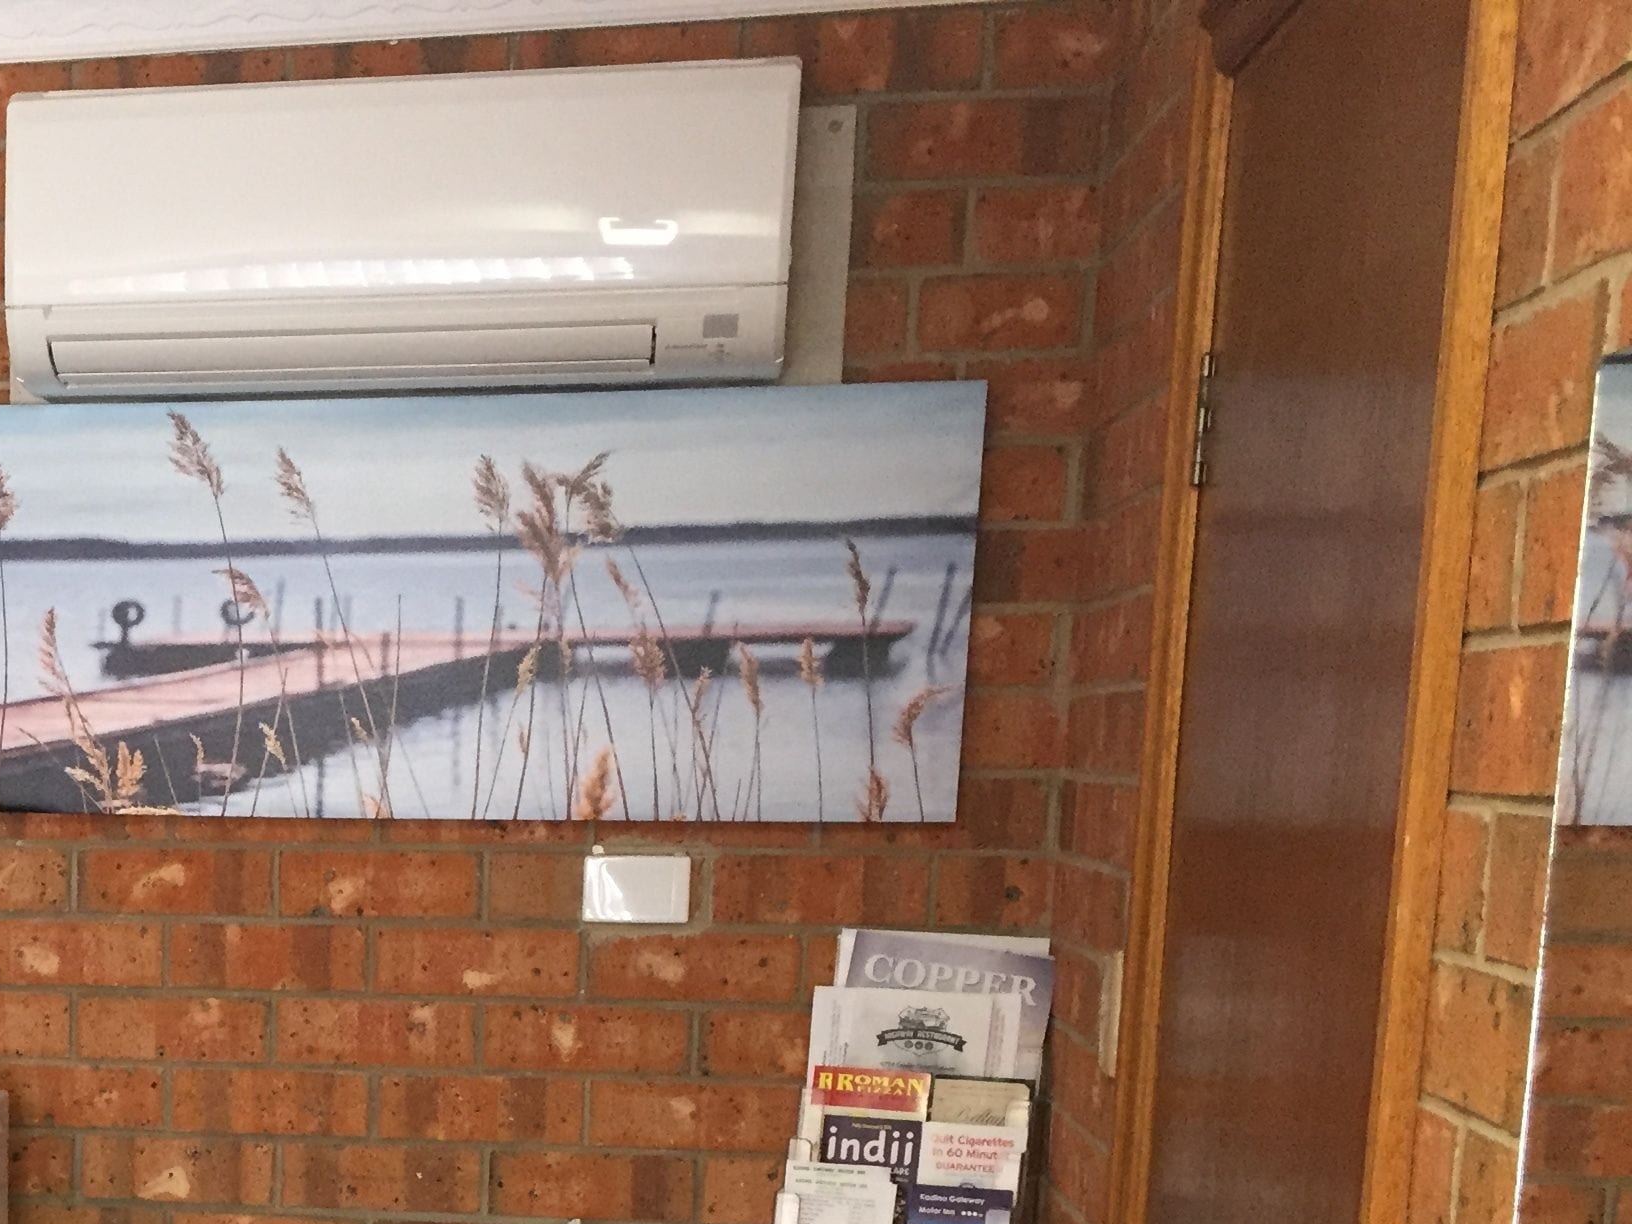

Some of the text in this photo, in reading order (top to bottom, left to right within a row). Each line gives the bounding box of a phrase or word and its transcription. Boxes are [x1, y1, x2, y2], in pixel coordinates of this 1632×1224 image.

[864, 954, 1037, 1006] COPPER
[836, 1073, 924, 1097] ROMAN
[827, 1125, 914, 1166] indii
[958, 1135, 1015, 1148] Cigarettes
[946, 1148, 963, 1158] 60
[966, 1149, 1009, 1160] Minut
[918, 1206, 942, 1214] Motor
